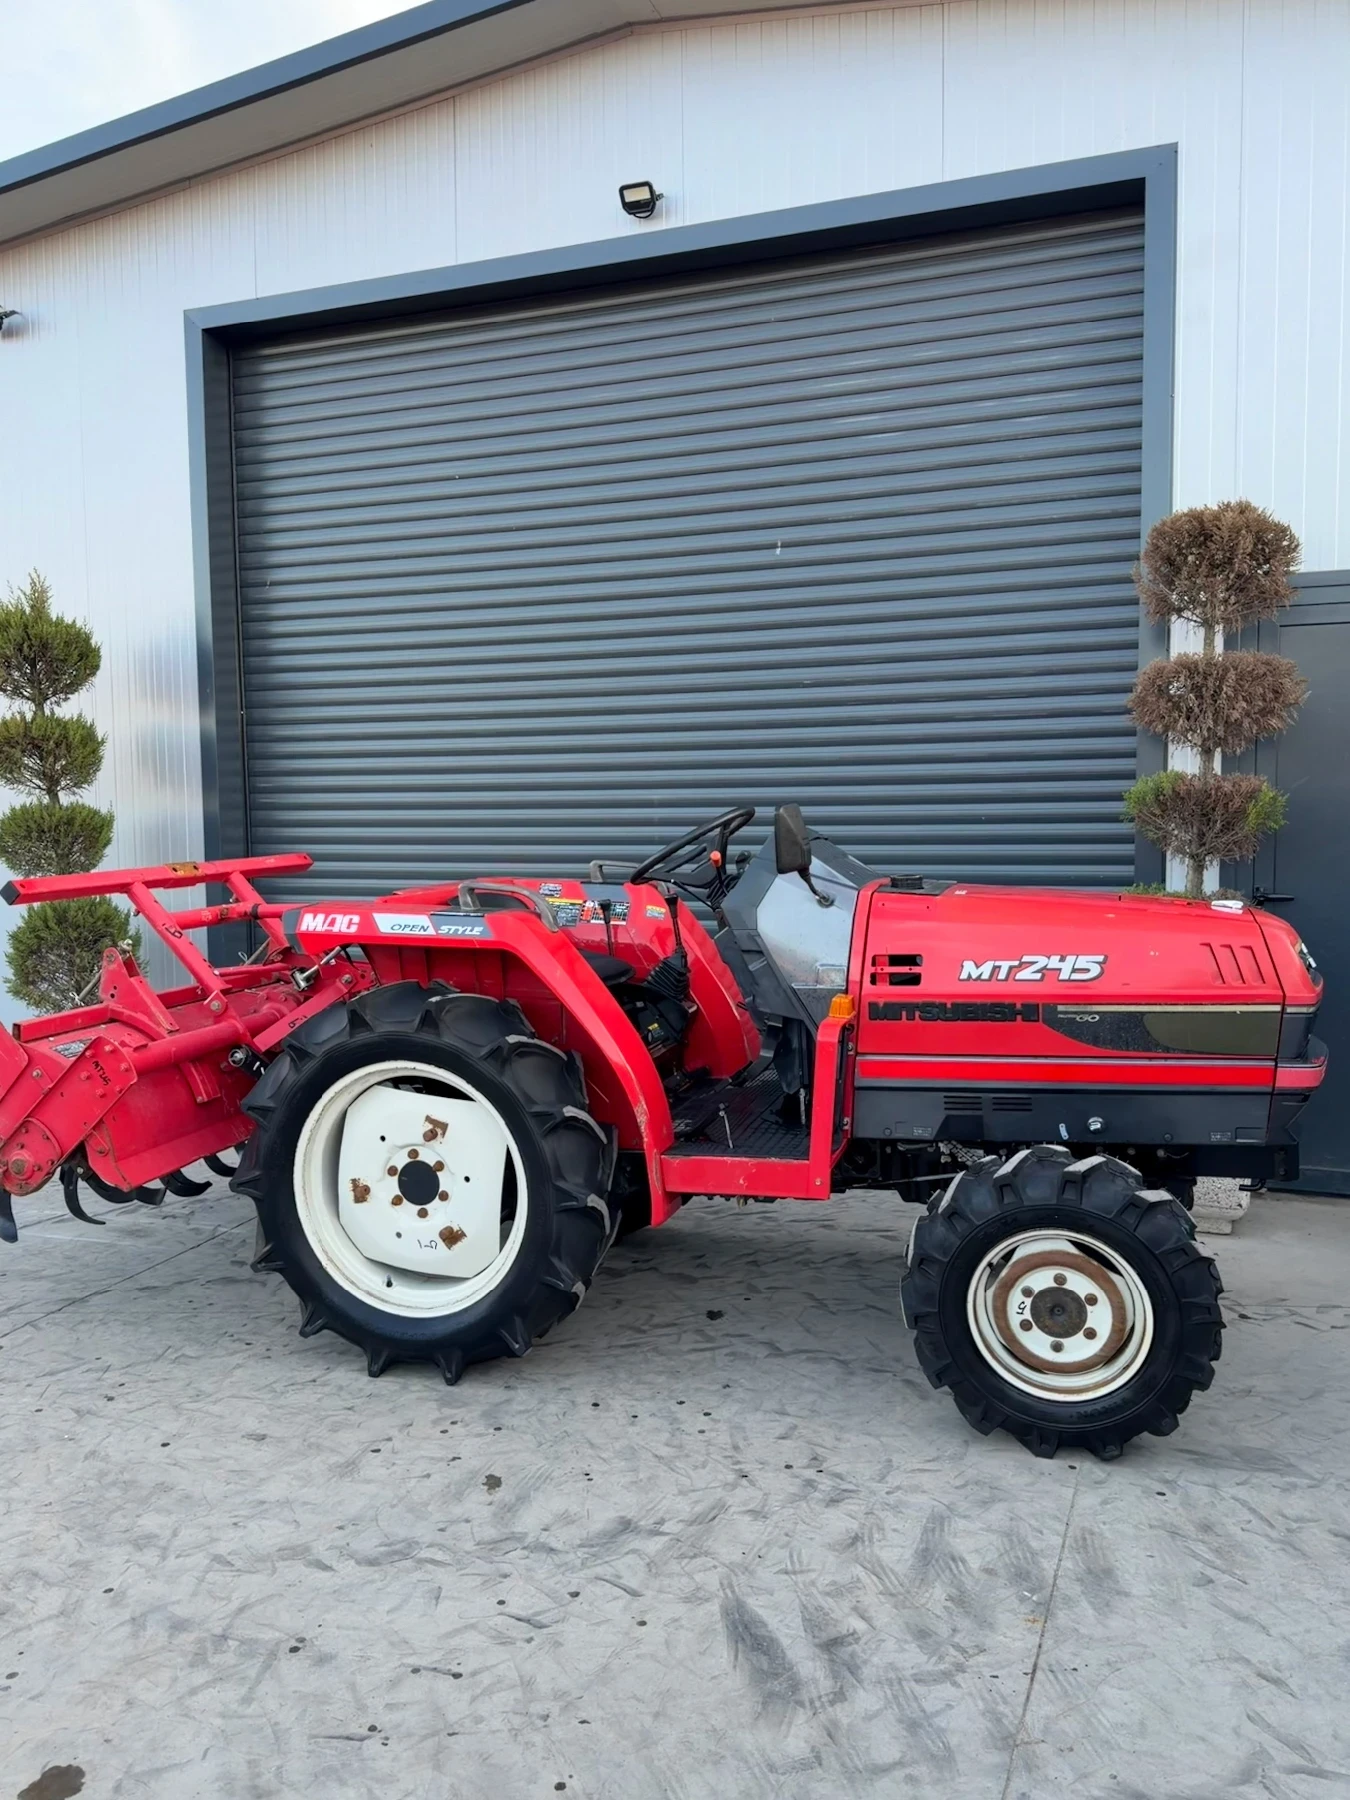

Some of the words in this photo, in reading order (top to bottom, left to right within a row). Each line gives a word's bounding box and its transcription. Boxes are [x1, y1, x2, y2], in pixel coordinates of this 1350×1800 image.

[300, 913, 360, 933] MAC
[390, 923, 430, 933] OPEN
[438, 925, 483, 935] STYLE
[958, 954, 1107, 982] MT245
[868, 1002, 1040, 1022] MITSUBISHI
